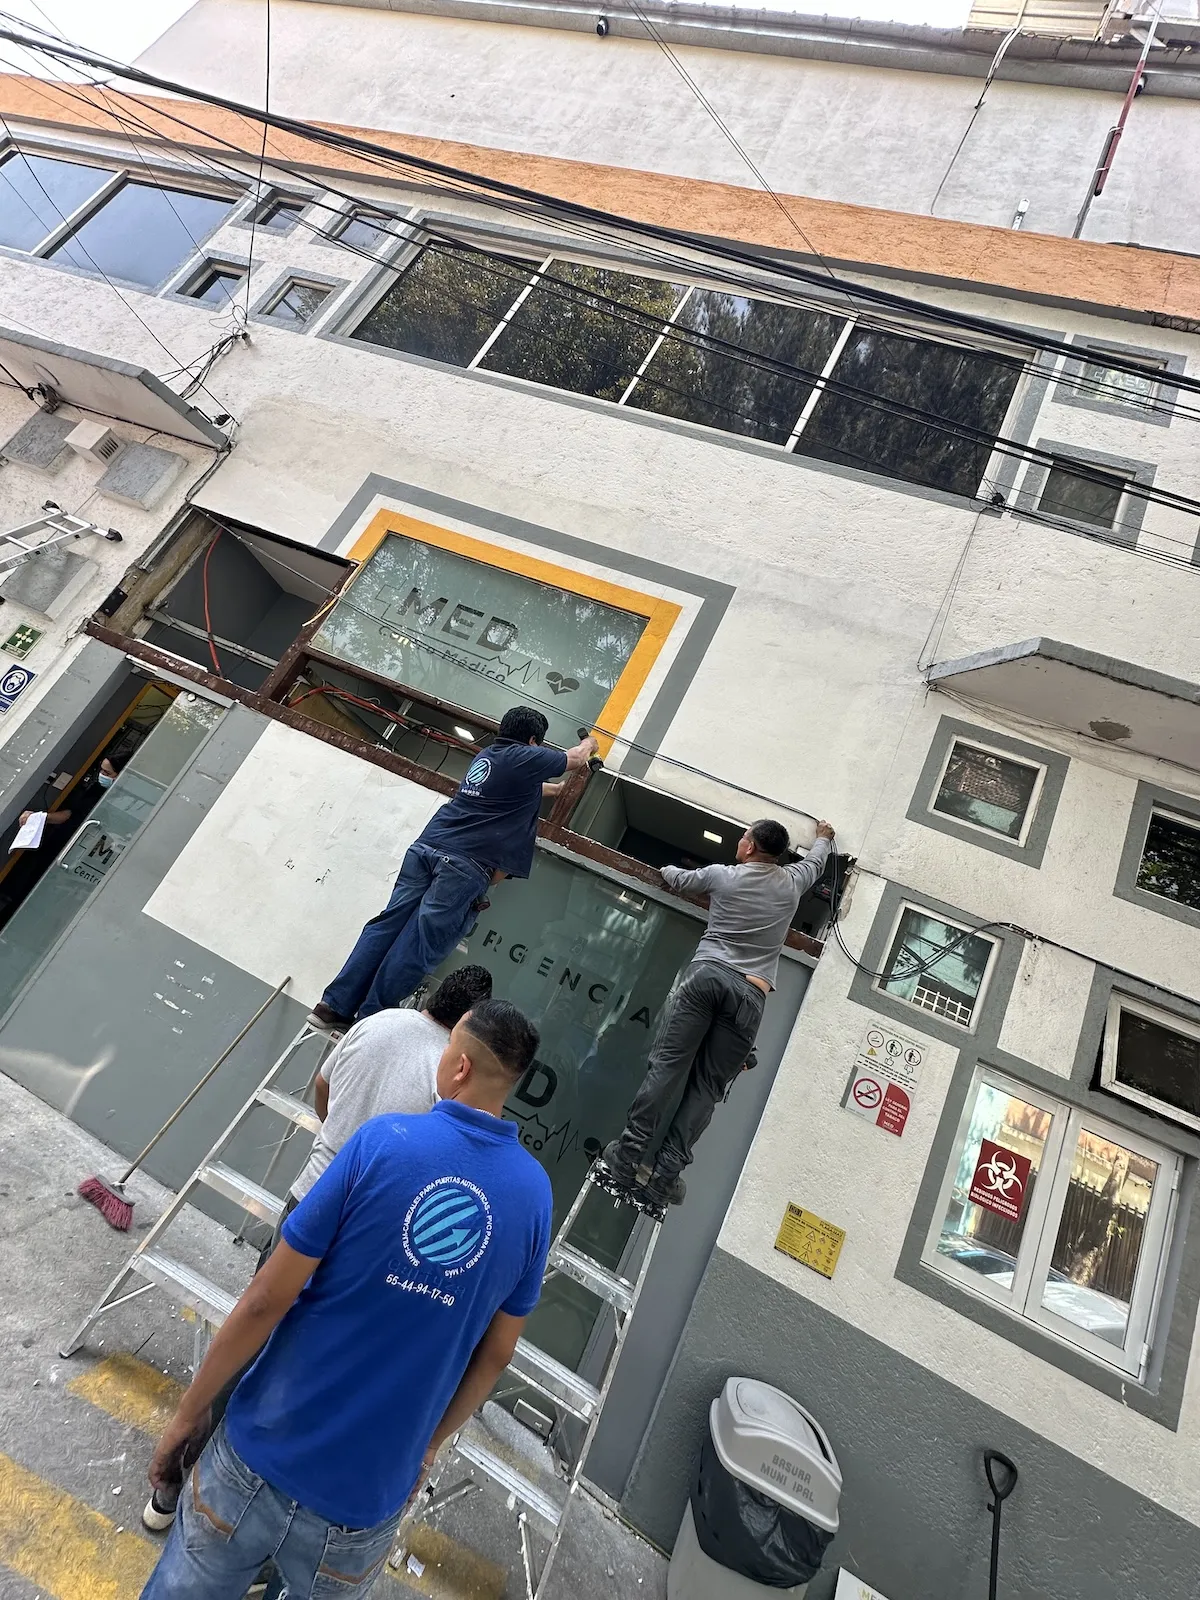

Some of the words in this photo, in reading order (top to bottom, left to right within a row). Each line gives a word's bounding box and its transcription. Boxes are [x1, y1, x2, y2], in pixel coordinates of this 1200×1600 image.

[397, 587, 519, 652] MED
[440, 648, 506, 683] Médico
[419, 1182, 435, 1198] PARA
[434, 1175, 460, 1186] PUERTAS
[973, 1186, 993, 1199] RESIDUOS
[992, 1195, 1018, 1211] PELIGROSOS
[991, 1201, 1018, 1218] INFECCIOSOS
[480, 1230, 492, 1249] PARA
[465, 1249, 484, 1269] PARED
[386, 1273, 455, 1307] 55-44-94-17-50
[772, 1454, 812, 1485] BASURA
